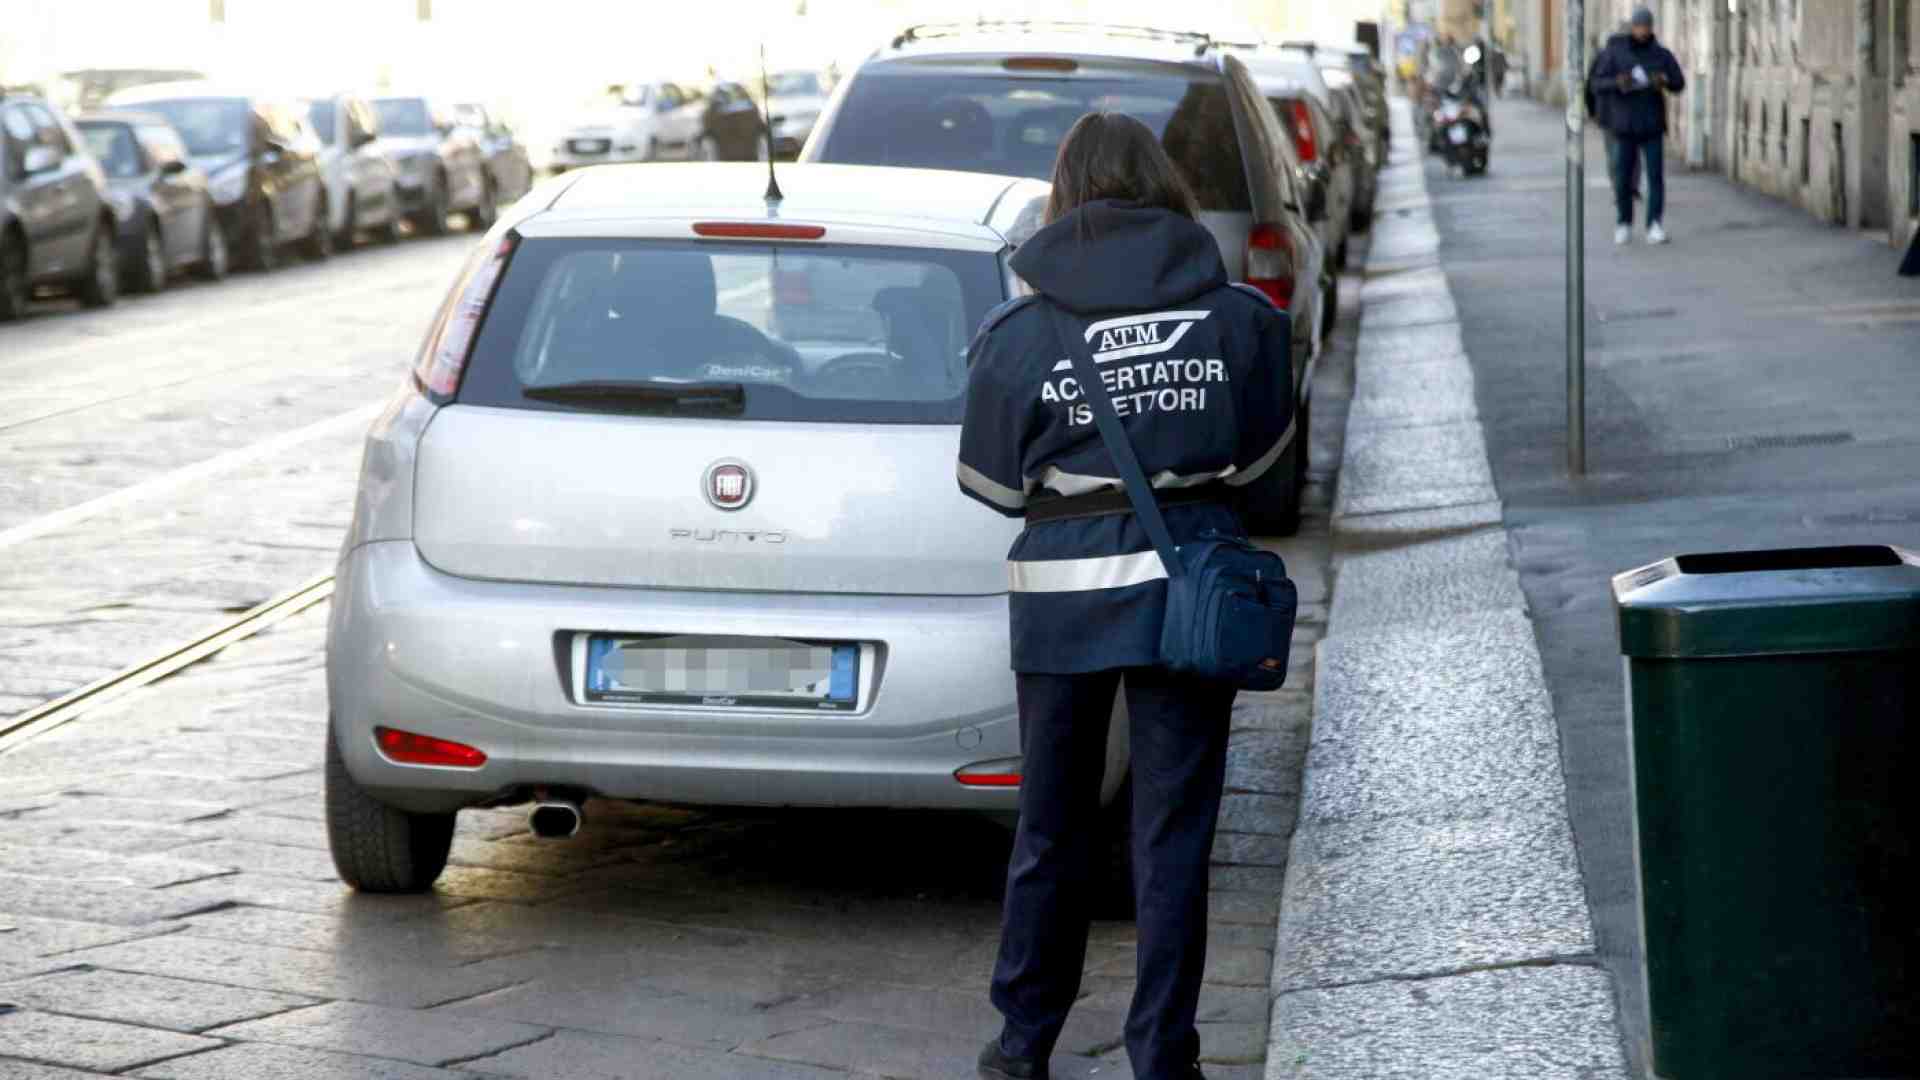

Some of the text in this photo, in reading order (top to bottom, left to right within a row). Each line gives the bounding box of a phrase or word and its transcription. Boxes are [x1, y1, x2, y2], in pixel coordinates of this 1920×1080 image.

[1100, 322, 1161, 351] ATM
[1041, 358, 1229, 403] ACERTATOR
[1068, 388, 1206, 426] ISETTORI
[716, 475, 742, 496] FIAT
[669, 528, 787, 544] PUNTO
